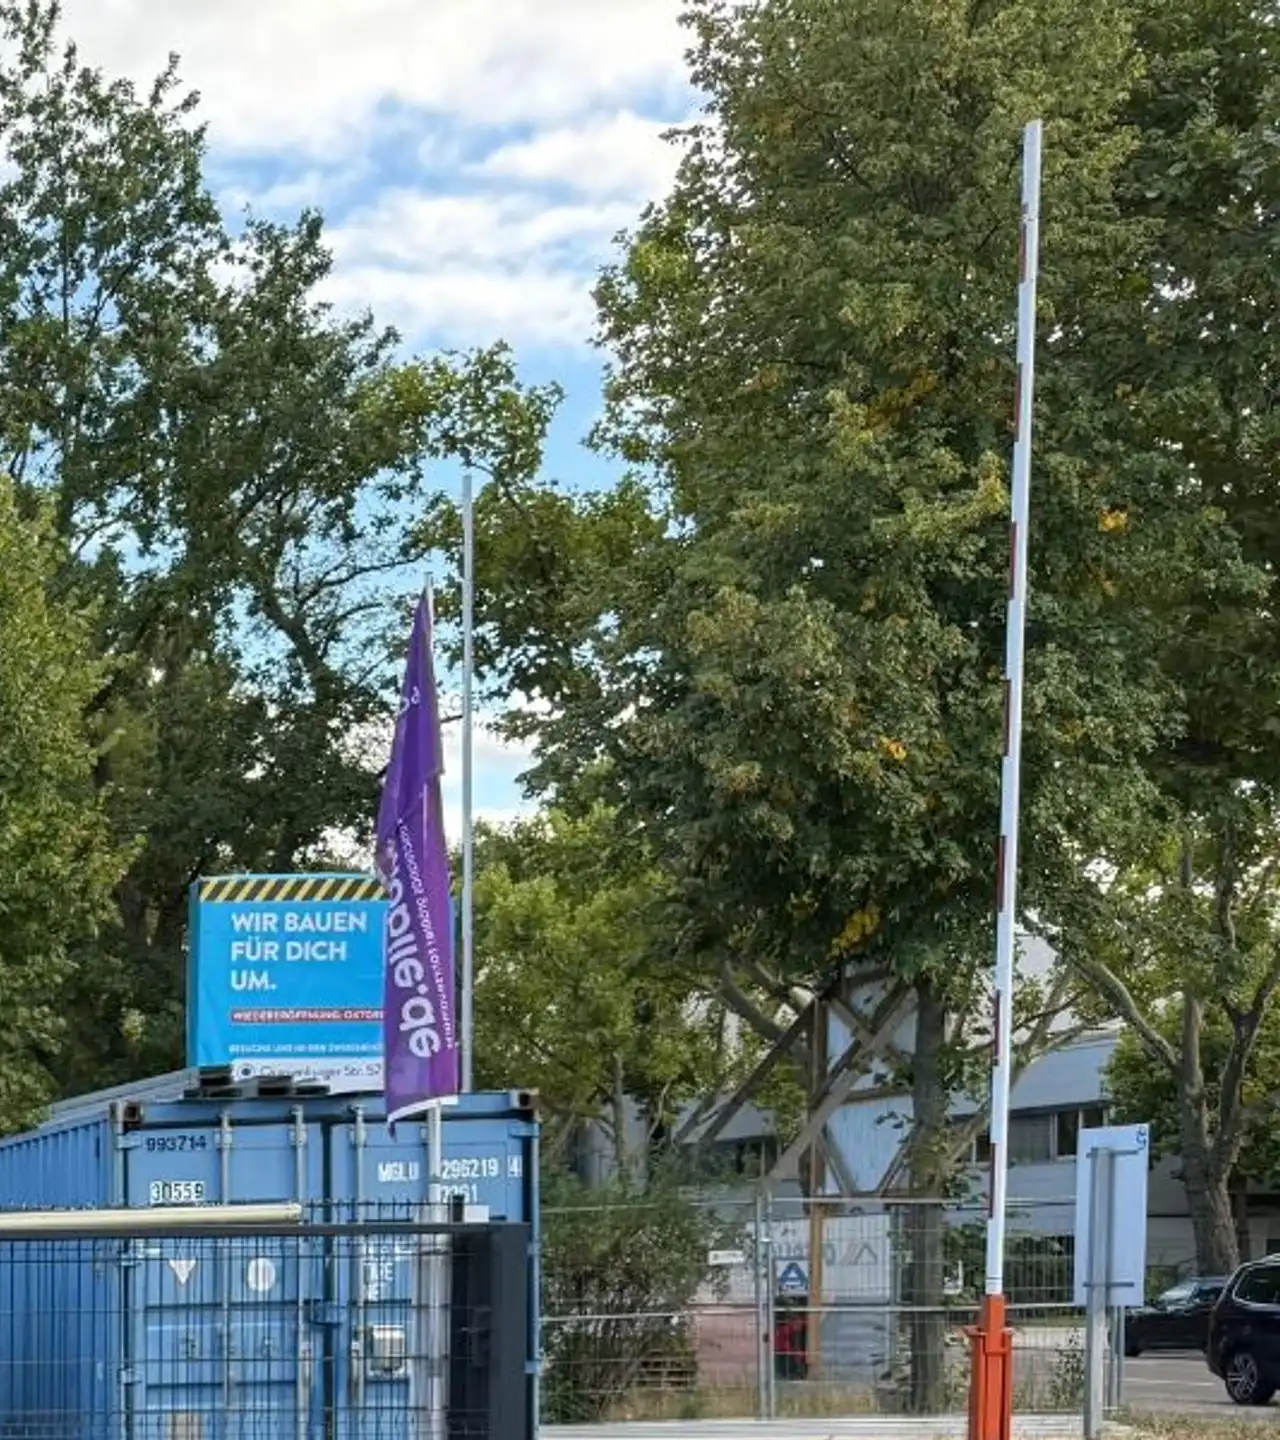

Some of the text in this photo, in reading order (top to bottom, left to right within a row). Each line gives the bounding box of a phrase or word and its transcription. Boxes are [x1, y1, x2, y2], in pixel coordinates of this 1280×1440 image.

[231, 911, 367, 932] WIR BAUEN
[231, 936, 347, 961] FÜR DICH
[231, 970, 277, 990] UM.
[508, 1155, 522, 1177] 4
[151, 1182, 204, 1202] 30559
